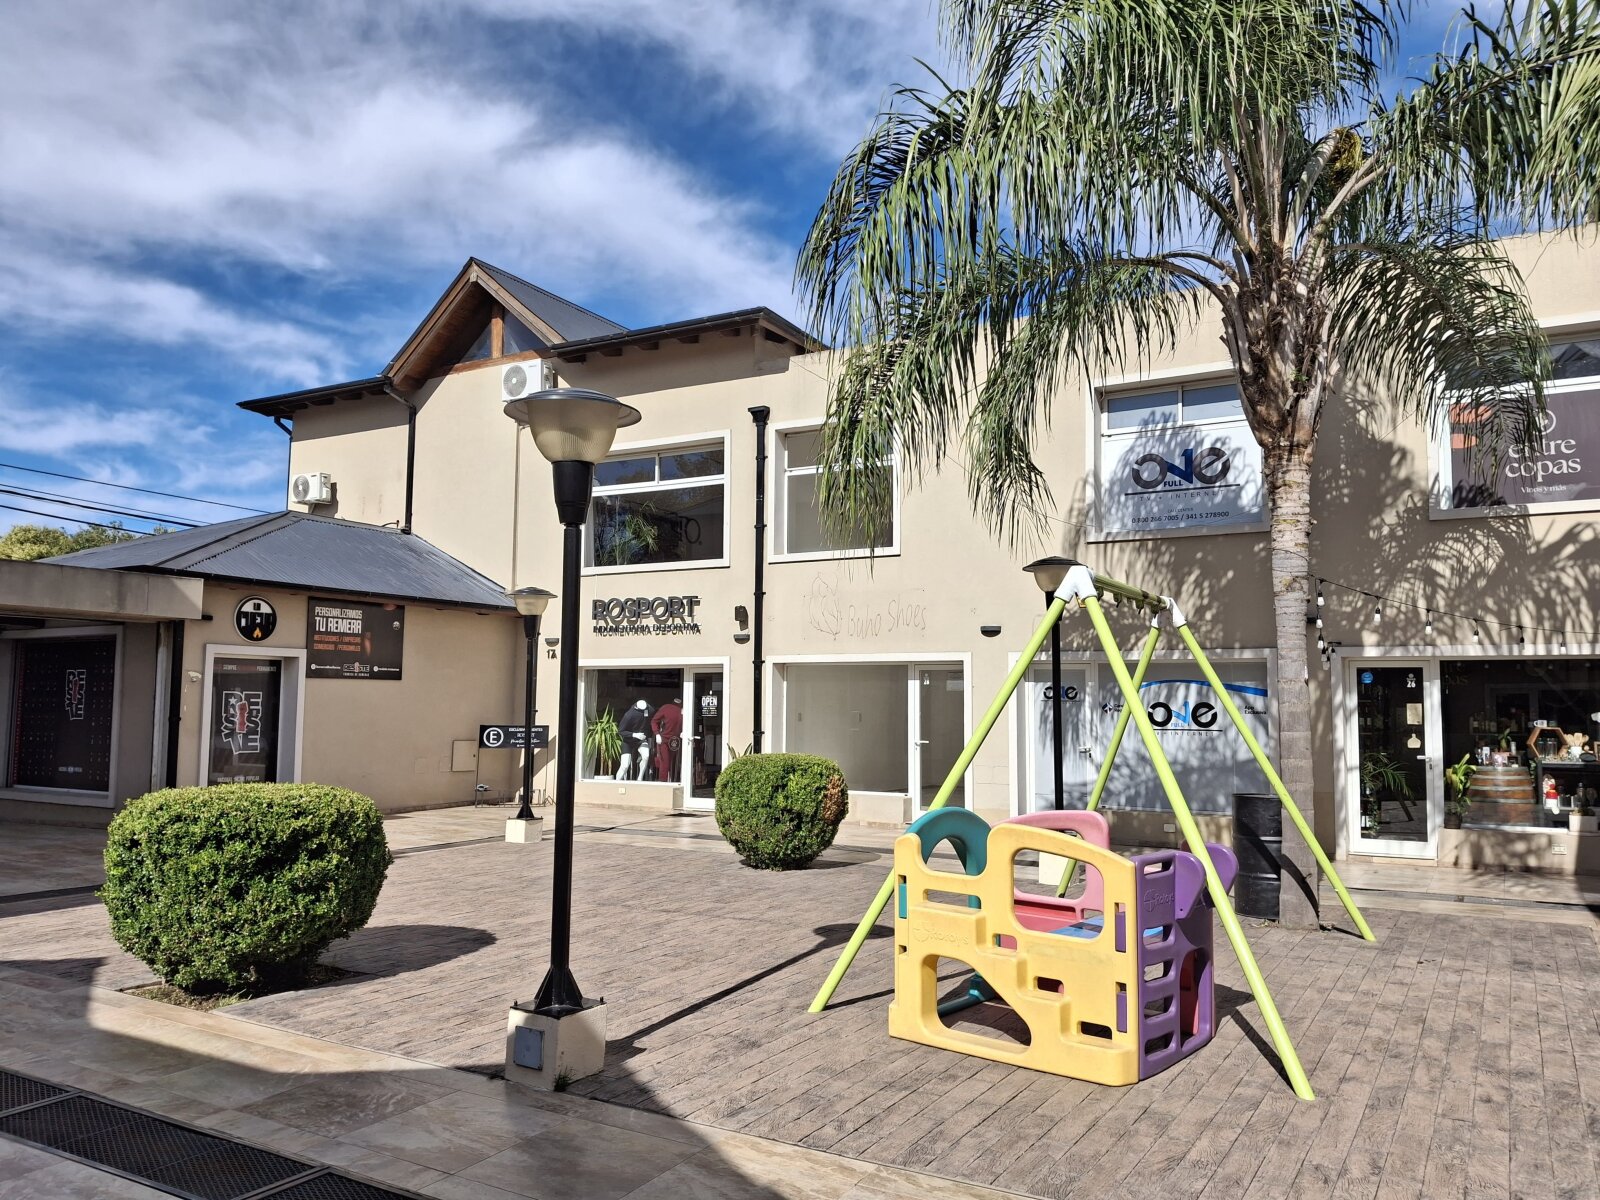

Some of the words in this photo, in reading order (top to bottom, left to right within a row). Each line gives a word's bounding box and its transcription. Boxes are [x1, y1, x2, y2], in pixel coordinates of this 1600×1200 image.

[1505, 458, 1582, 483] copas
[1163, 480, 1183, 488] FULL
[1185, 512, 1200, 520] 341
[1205, 511, 1230, 519] 278900
[314, 606, 363, 619] PERSONALIZAMOS
[592, 595, 699, 622] ROSPORT
[888, 594, 926, 632] Shoes
[315, 616, 327, 632] TU
[327, 618, 362, 634] REMERA
[701, 697, 718, 706] OPEN
